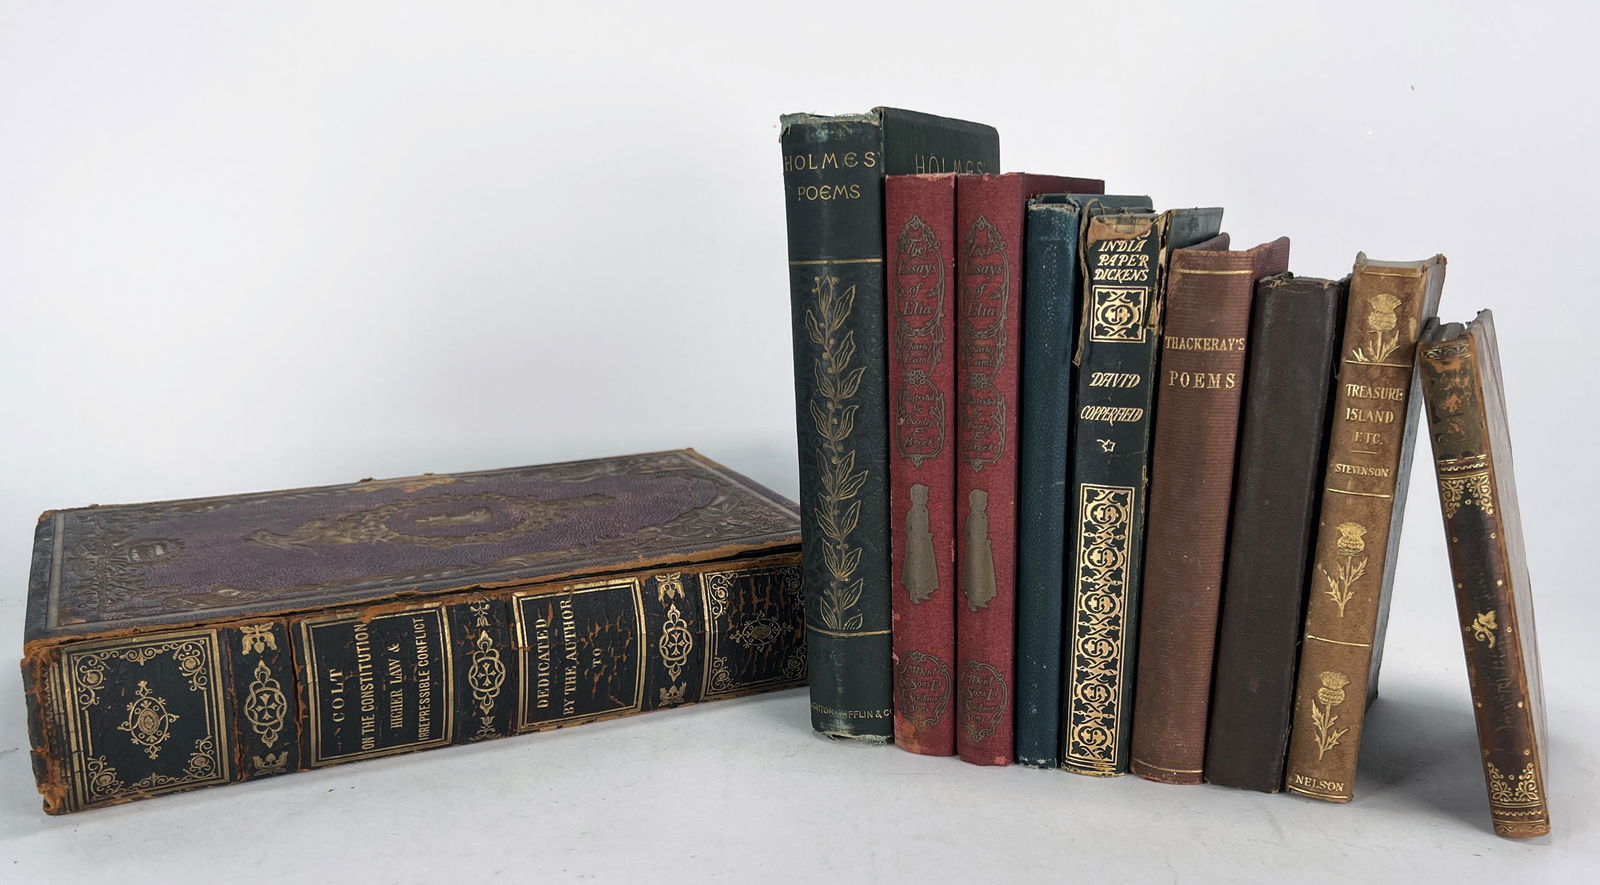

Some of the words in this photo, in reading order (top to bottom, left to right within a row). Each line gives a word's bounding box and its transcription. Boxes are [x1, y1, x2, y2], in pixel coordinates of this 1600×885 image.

[797, 184, 861, 201] POEMS
[1098, 236, 1147, 252] INDIA
[1097, 254, 1149, 267] PAPER
[898, 261, 937, 278] Essays
[1093, 268, 1149, 283] DICKENS
[909, 283, 924, 297] of
[974, 284, 989, 298] of
[903, 302, 931, 316] Elia
[967, 303, 997, 317] Elia
[1165, 336, 1246, 351] THACKERAY'S
[1089, 372, 1141, 389] DAVID
[1168, 370, 1236, 389] POEMS
[1345, 383, 1403, 401] TREASURE
[1081, 405, 1144, 425] COPPERFIELD
[1346, 407, 1394, 424] ISLAND
[1335, 463, 1390, 478] STEVENSON
[387, 642, 400, 652] &
[536, 617, 550, 709] DEDICATED
[592, 647, 602, 668] TO
[354, 623, 376, 712] CONSTITUTION
[388, 658, 403, 685] LAW
[564, 665, 577, 697] THE
[328, 668, 345, 723] COLT
[390, 688, 404, 729] HIGHER
[418, 669, 431, 741] IRREPRESSIBLE
[563, 699, 575, 715] BY
[875, 710, 883, 719] &
[361, 713, 375, 736] THE
[361, 736, 375, 750] ON
[1295, 774, 1345, 792] NELSON
